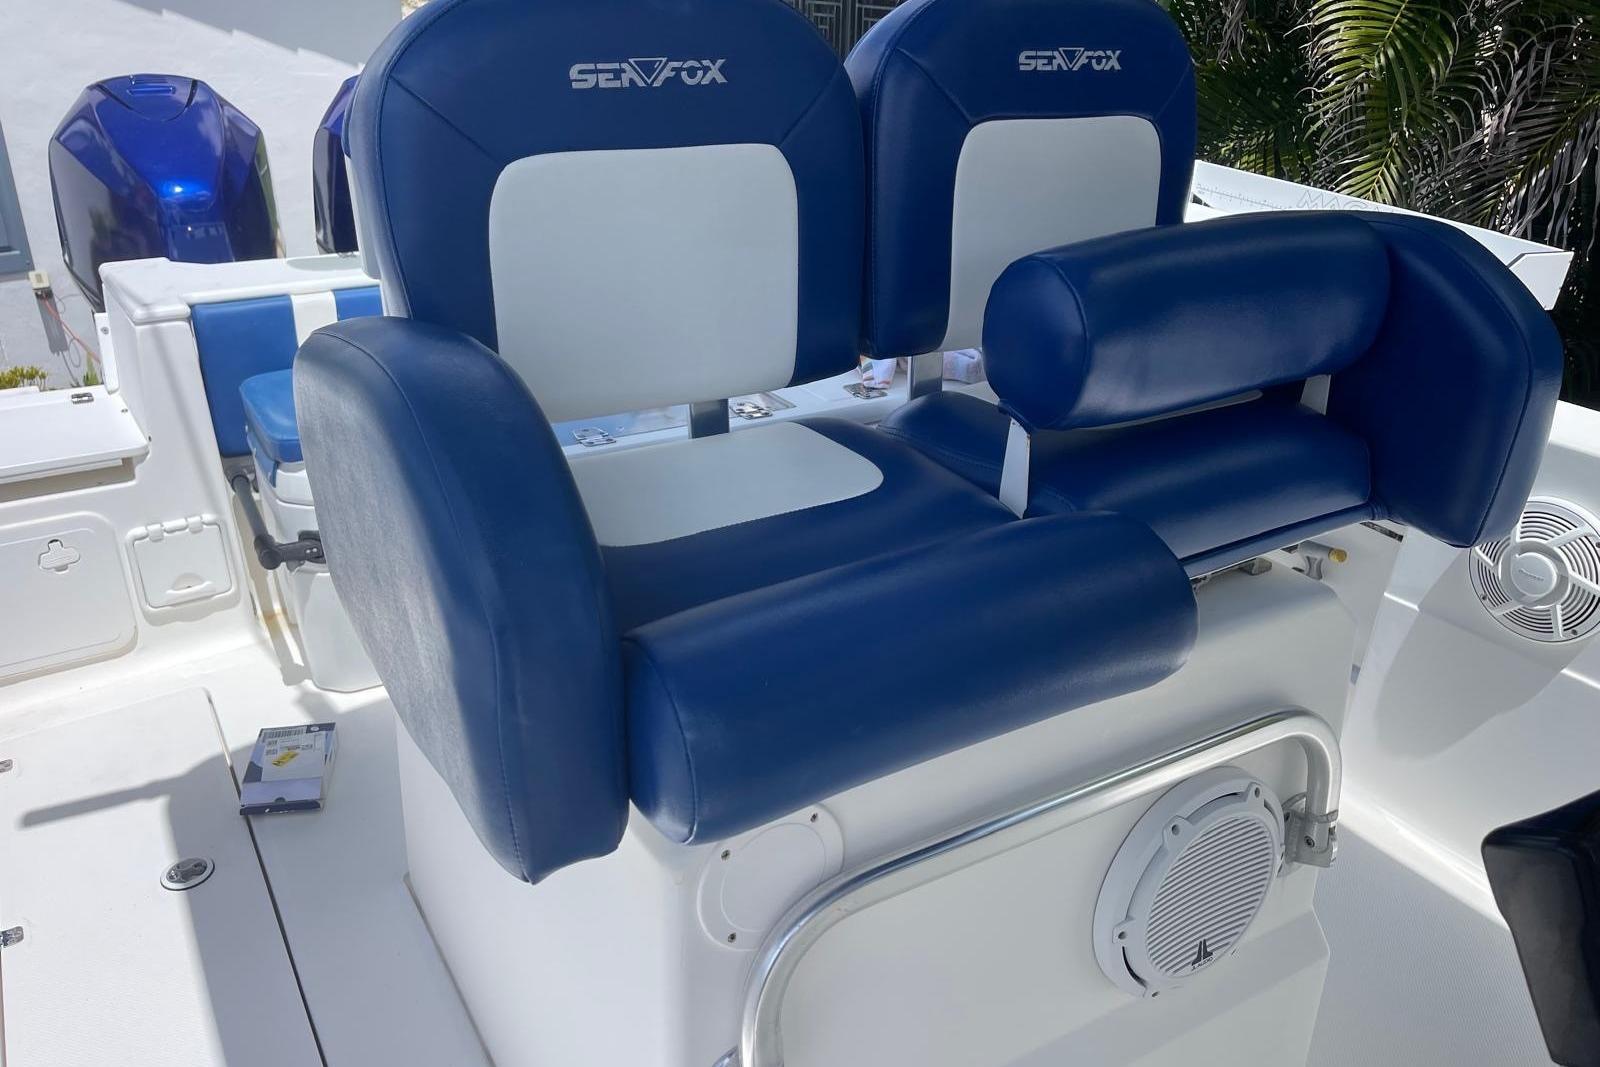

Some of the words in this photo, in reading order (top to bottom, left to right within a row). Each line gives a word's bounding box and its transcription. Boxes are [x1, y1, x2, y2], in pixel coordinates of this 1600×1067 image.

[1018, 50, 1069, 71] SEA
[1071, 50, 1122, 71] FOX
[569, 62, 647, 89] SEA
[652, 59, 728, 87] FOX
